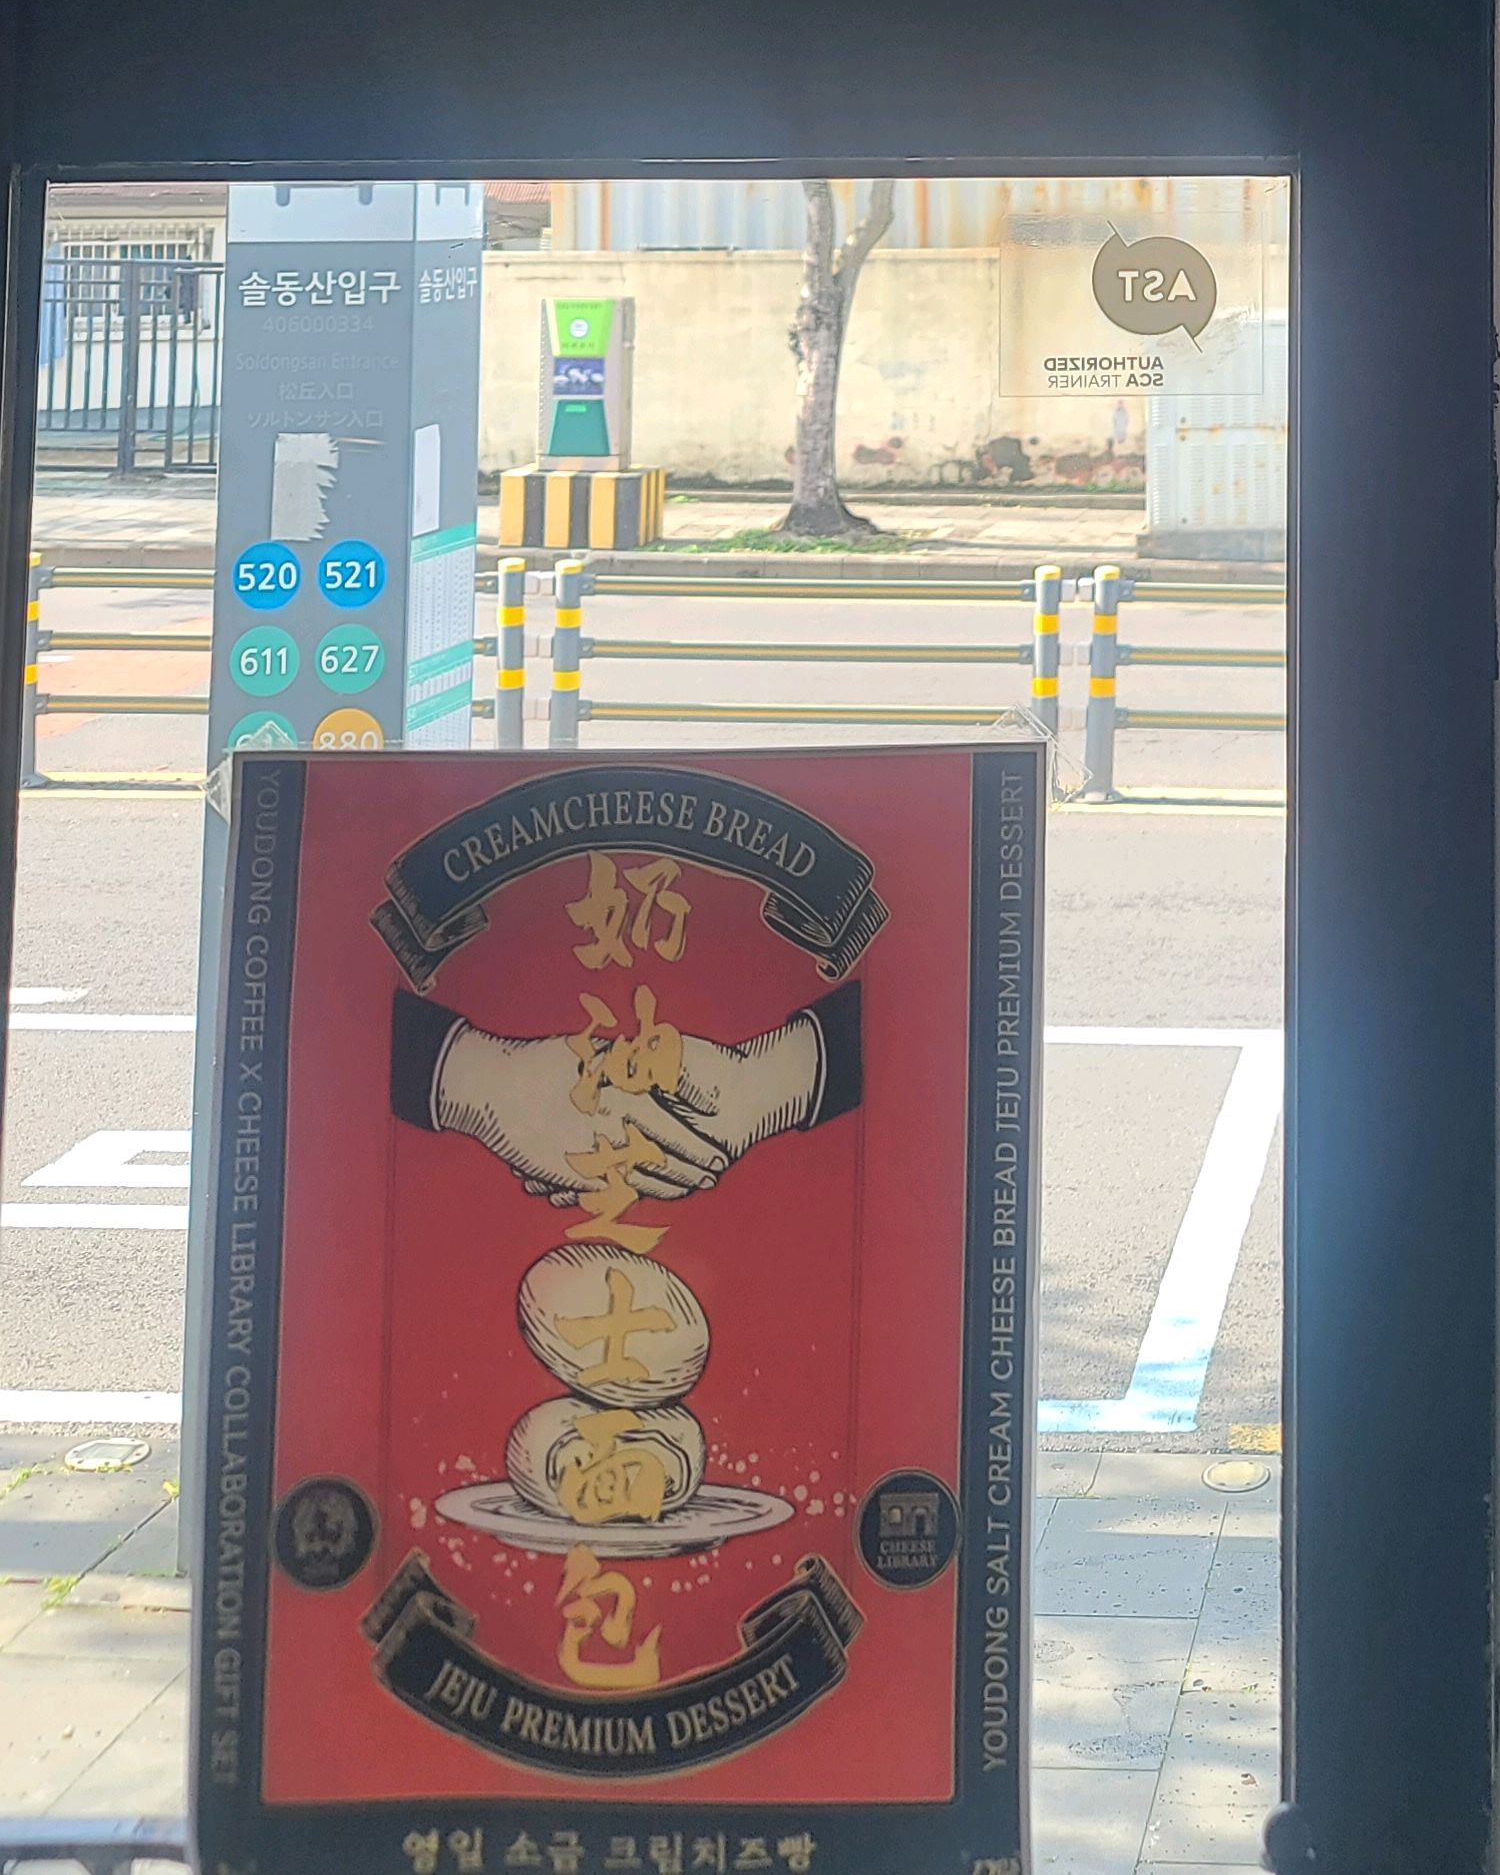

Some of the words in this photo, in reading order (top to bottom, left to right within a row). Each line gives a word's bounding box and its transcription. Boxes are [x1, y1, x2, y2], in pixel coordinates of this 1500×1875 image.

[238, 270, 402, 307] 솔동산입구
[418, 266, 478, 305] 솔동산입구
[236, 352, 327, 374] Soldongsan
[332, 353, 400, 370] Entrance
[238, 562, 297, 591] 520
[325, 559, 379, 589] 521
[239, 647, 289, 677] 611
[320, 644, 380, 674] 627
[247, 770, 281, 925] YOUDONG
[443, 791, 698, 883] CREAMCHEESE
[703, 801, 817, 878] BREAD
[1001, 771, 1024, 902] DESSERT
[240, 935, 270, 1051] COFFEE
[997, 912, 1022, 1057] PREMIUM
[996, 1067, 1021, 1132] JEJU
[233, 1091, 263, 1212] CHEESE
[993, 1142, 1018, 1246] BREAD
[227, 1221, 257, 1355] LIBRARY
[990, 1257, 1015, 1381] CHEESE
[987, 1392, 1013, 1506] CREAM
[215, 1366, 252, 1640] COLLABORATION
[986, 1516, 1011, 1596] SALT
[213, 1647, 243, 1724] GIFT
[425, 1659, 498, 1722] JEJU
[500, 1696, 657, 1756] PREMIUM
[666, 1653, 801, 1749] DESSERT
[983, 1606, 1010, 1773] YOUDONG
[211, 1729, 239, 1787] SET
[504, 1831, 585, 1874] 소금
[603, 1831, 816, 1875] 크림치즈빵
